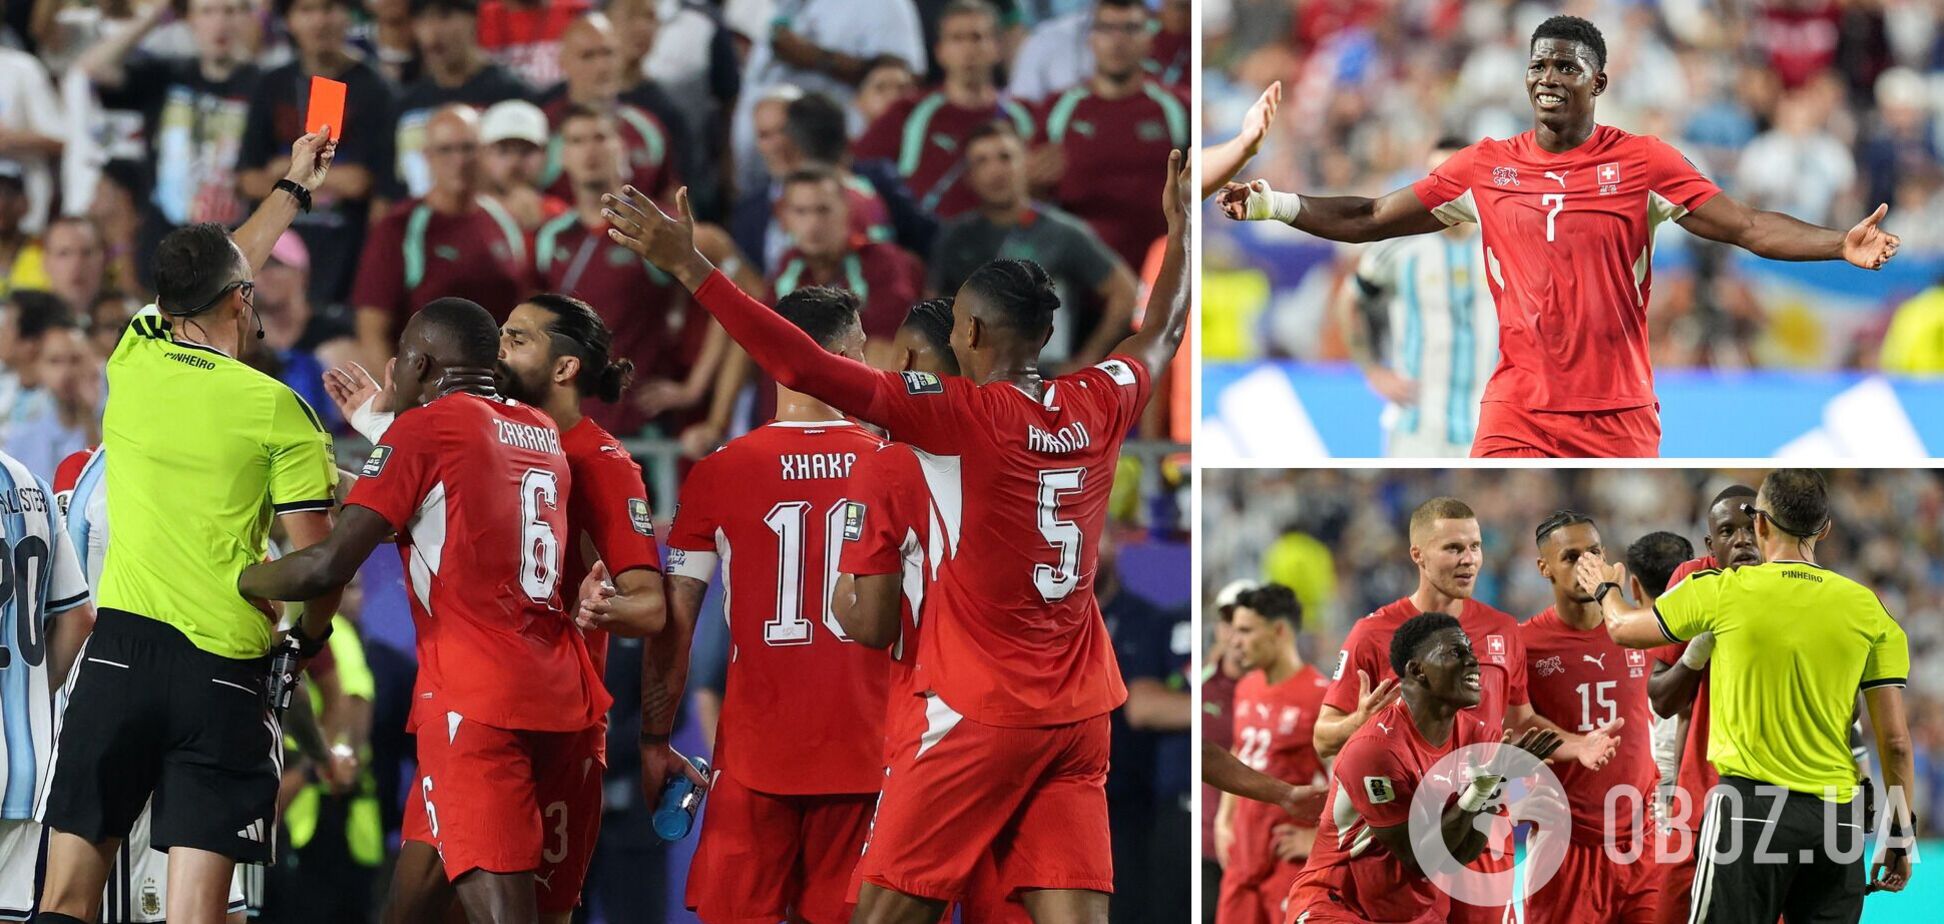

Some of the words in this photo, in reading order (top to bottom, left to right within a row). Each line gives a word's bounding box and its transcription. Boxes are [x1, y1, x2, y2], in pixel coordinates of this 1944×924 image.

[1541, 193, 1566, 242] 7
[493, 418, 561, 456] ZAKARIA
[520, 468, 559, 604] 6
[1033, 467, 1087, 603] 5
[1781, 570, 1823, 582] PINHEIRO
[1576, 681, 1617, 732] 15
[1238, 726, 1271, 771] 22
[543, 800, 568, 864] 3
